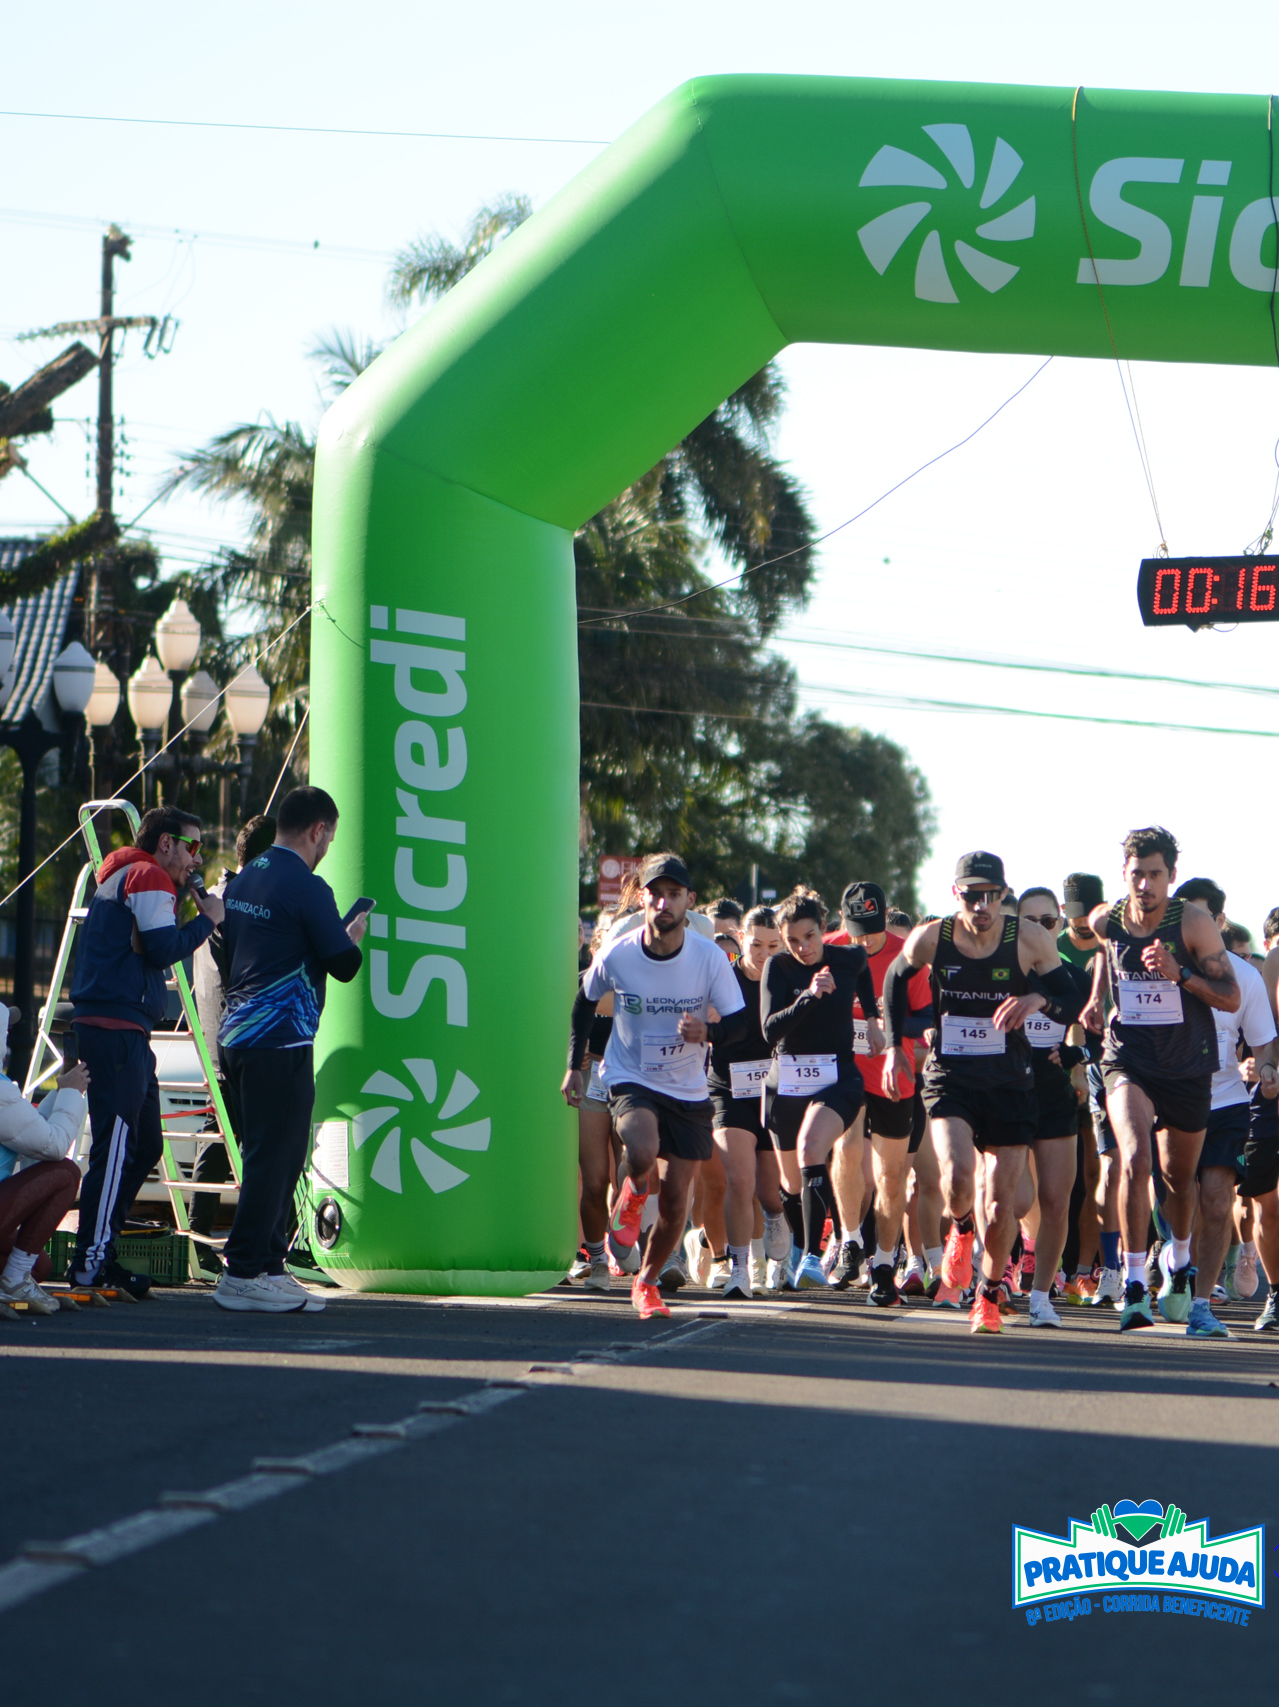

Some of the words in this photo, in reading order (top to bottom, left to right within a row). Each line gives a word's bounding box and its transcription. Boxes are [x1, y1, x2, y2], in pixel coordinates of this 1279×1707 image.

[1153, 565, 1276, 615] 00:16
[370, 604, 468, 1027] Sicredi
[646, 996, 704, 1007] LEONARDO
[1136, 993, 1162, 1004] 174
[1026, 1021, 1051, 1031] 185
[960, 1028, 987, 1039] 145
[660, 1043, 685, 1056] 177
[795, 1067, 820, 1078] 135
